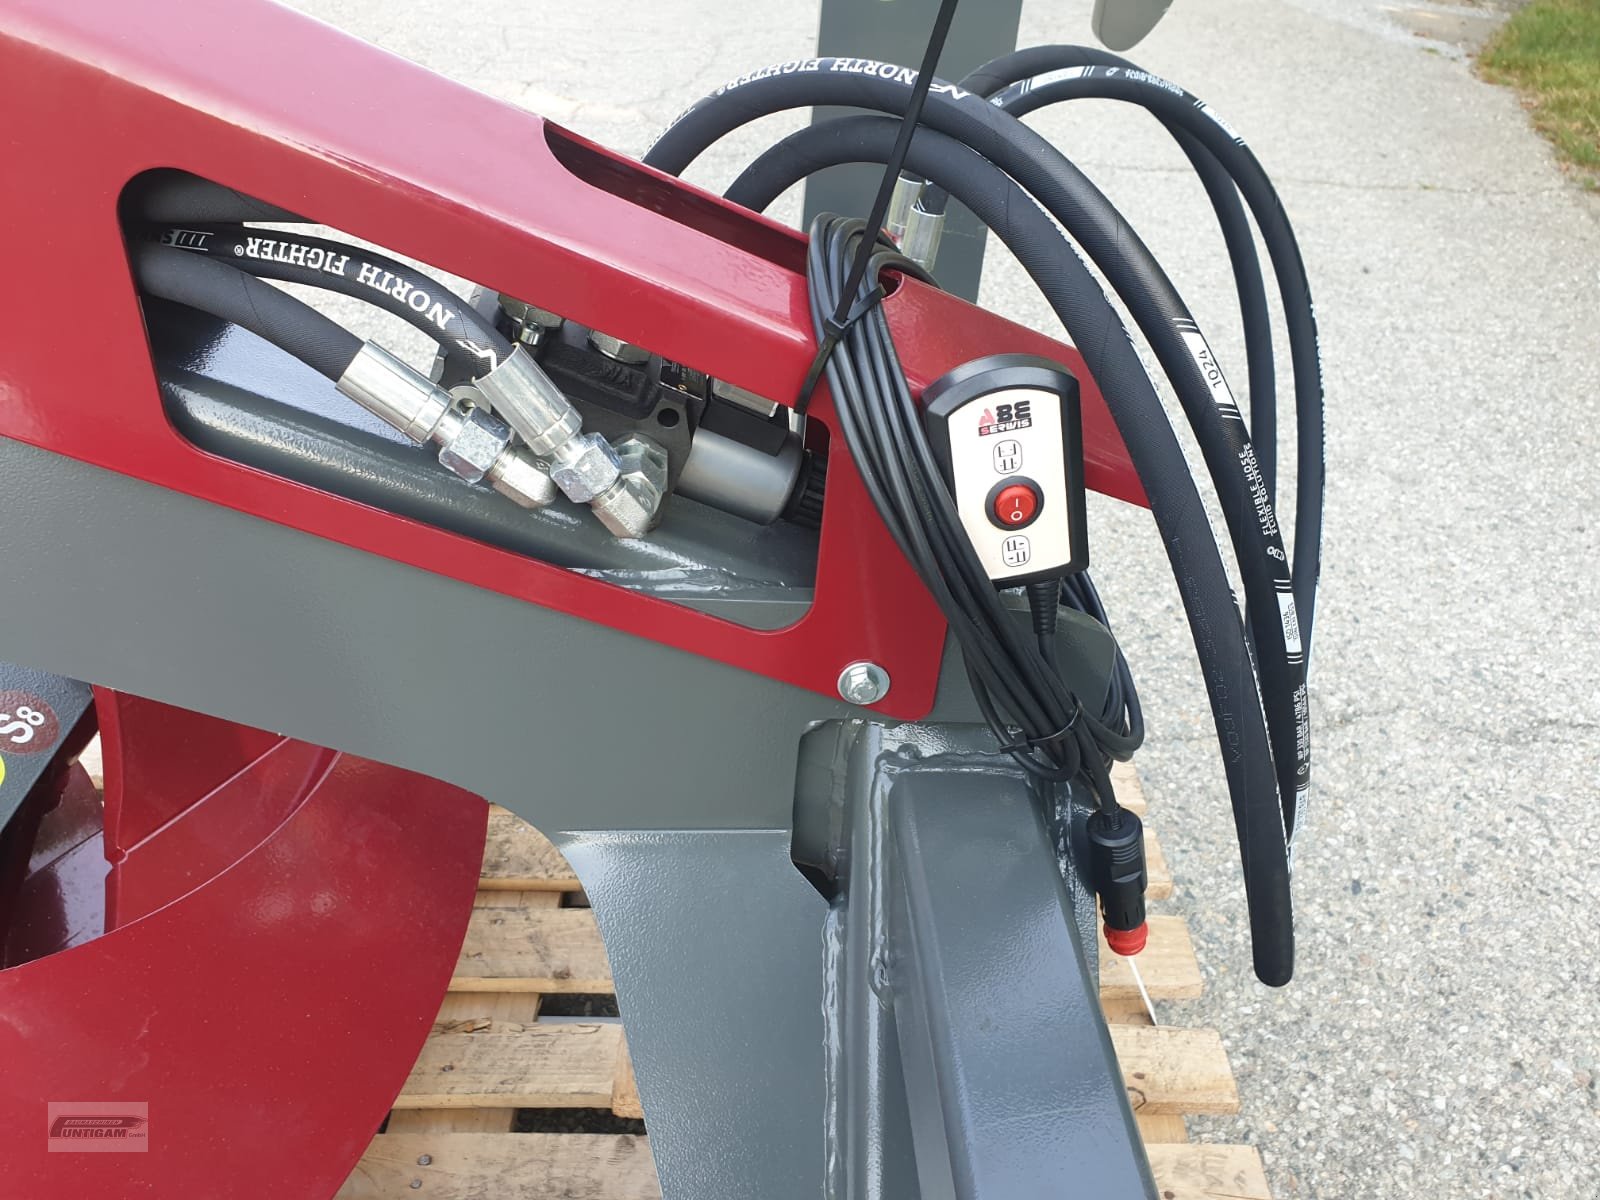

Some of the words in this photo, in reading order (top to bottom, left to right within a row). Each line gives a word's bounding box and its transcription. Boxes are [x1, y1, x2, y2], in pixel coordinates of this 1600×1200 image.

[831, 57, 919, 85] NORTH
[358, 261, 456, 330] NORTH
[978, 400, 1032, 426] ABE
[979, 417, 1032, 436] SERWIS
[1239, 451, 1255, 481] HOSE
[1244, 442, 1269, 502] SOLUTIONS
[1250, 485, 1271, 536] FLEXIBLE
